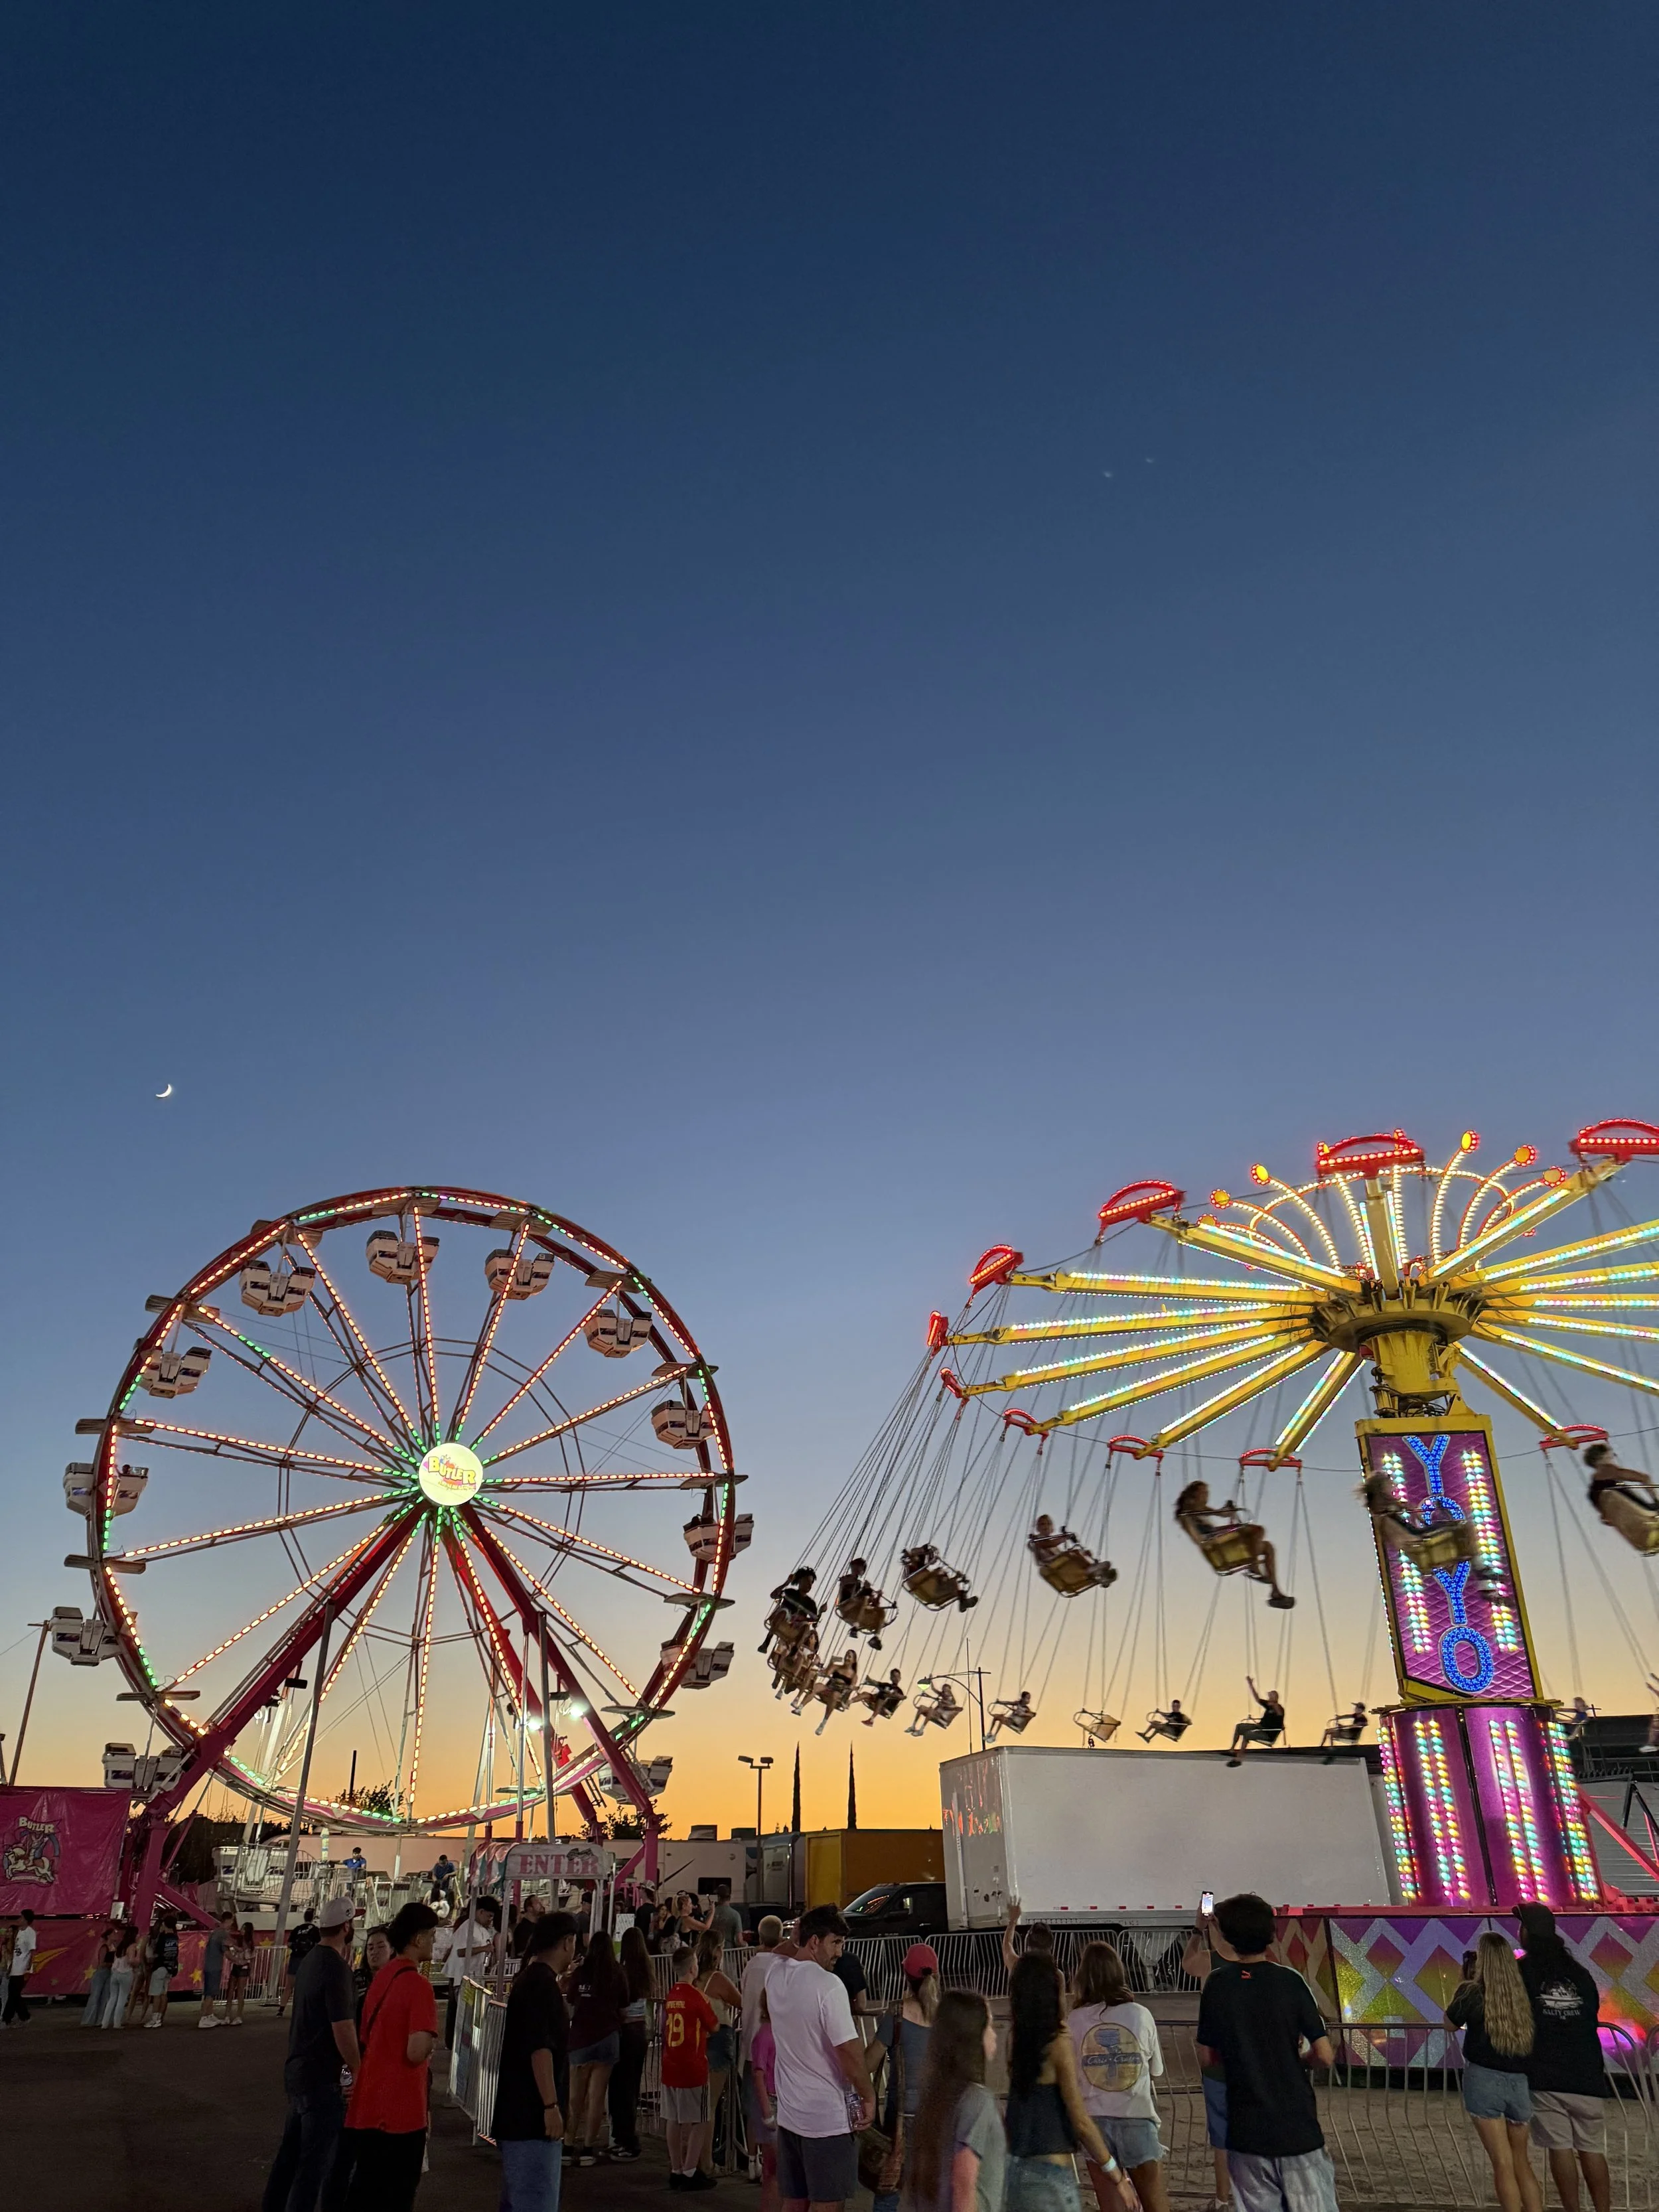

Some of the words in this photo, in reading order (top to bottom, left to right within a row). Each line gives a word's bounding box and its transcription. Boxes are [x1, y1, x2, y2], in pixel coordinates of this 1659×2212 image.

[428, 1456, 476, 1485] BUTLER
[19, 1817, 54, 1834] BUTLER
[518, 1854, 599, 1874] ENTER
[666, 2013, 685, 2047] 19
